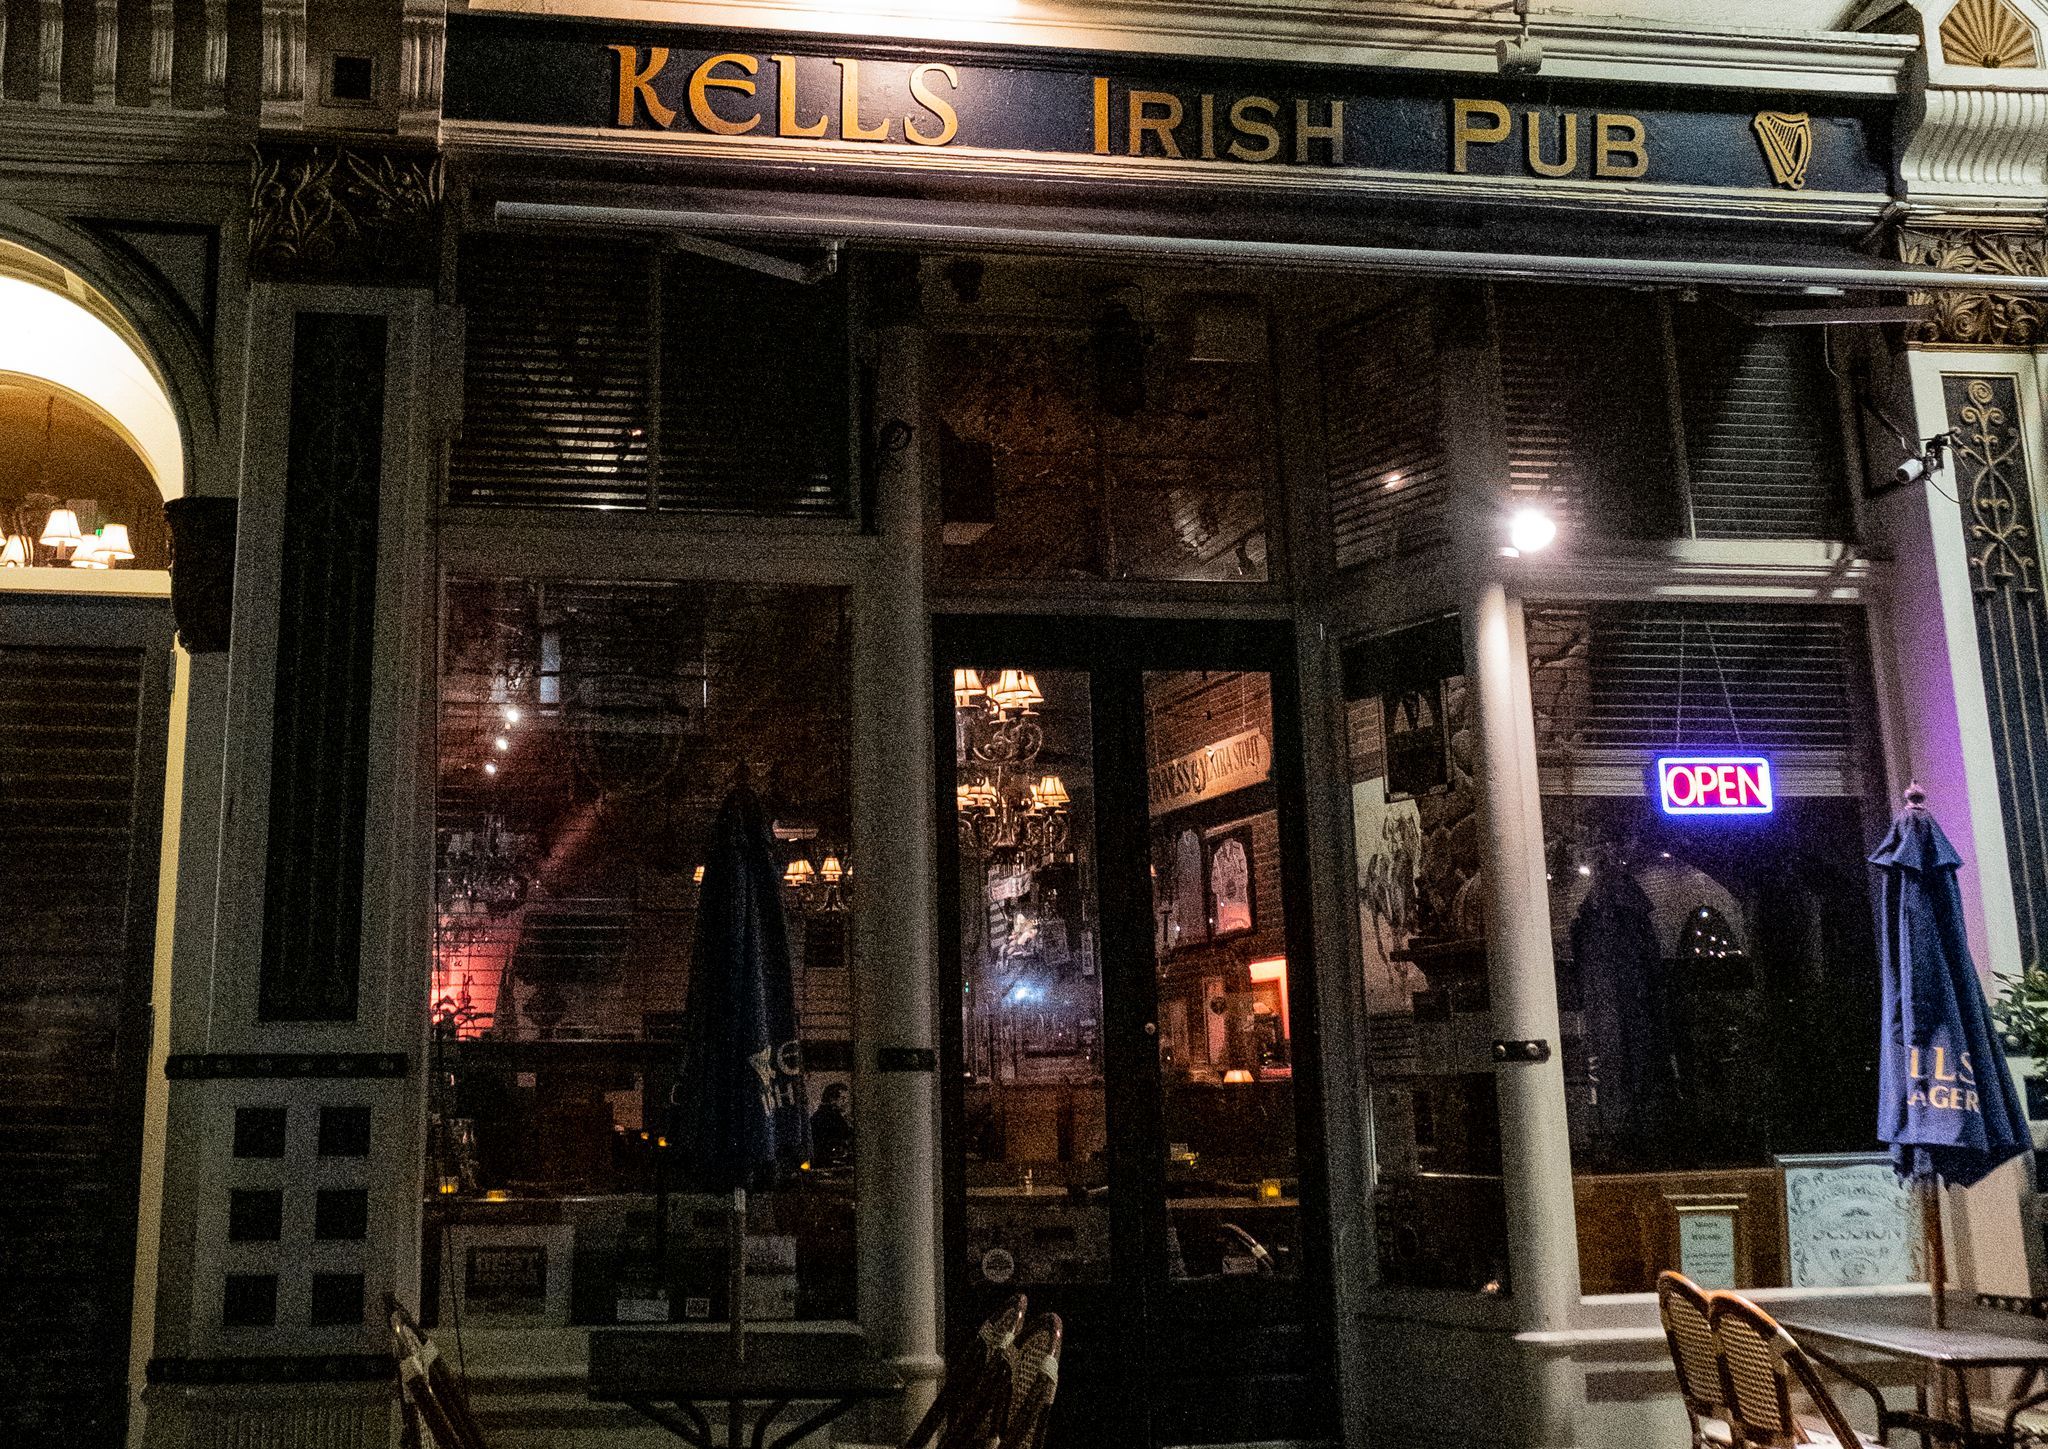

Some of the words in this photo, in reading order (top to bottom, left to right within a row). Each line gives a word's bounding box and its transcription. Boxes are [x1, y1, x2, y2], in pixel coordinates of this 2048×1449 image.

[607, 44, 959, 147] KELLS
[1093, 77, 1345, 164] IRISH
[1453, 98, 1650, 178] PUB
[1667, 765, 1769, 806] OPEN
[1906, 1084, 1980, 1115] AGER
